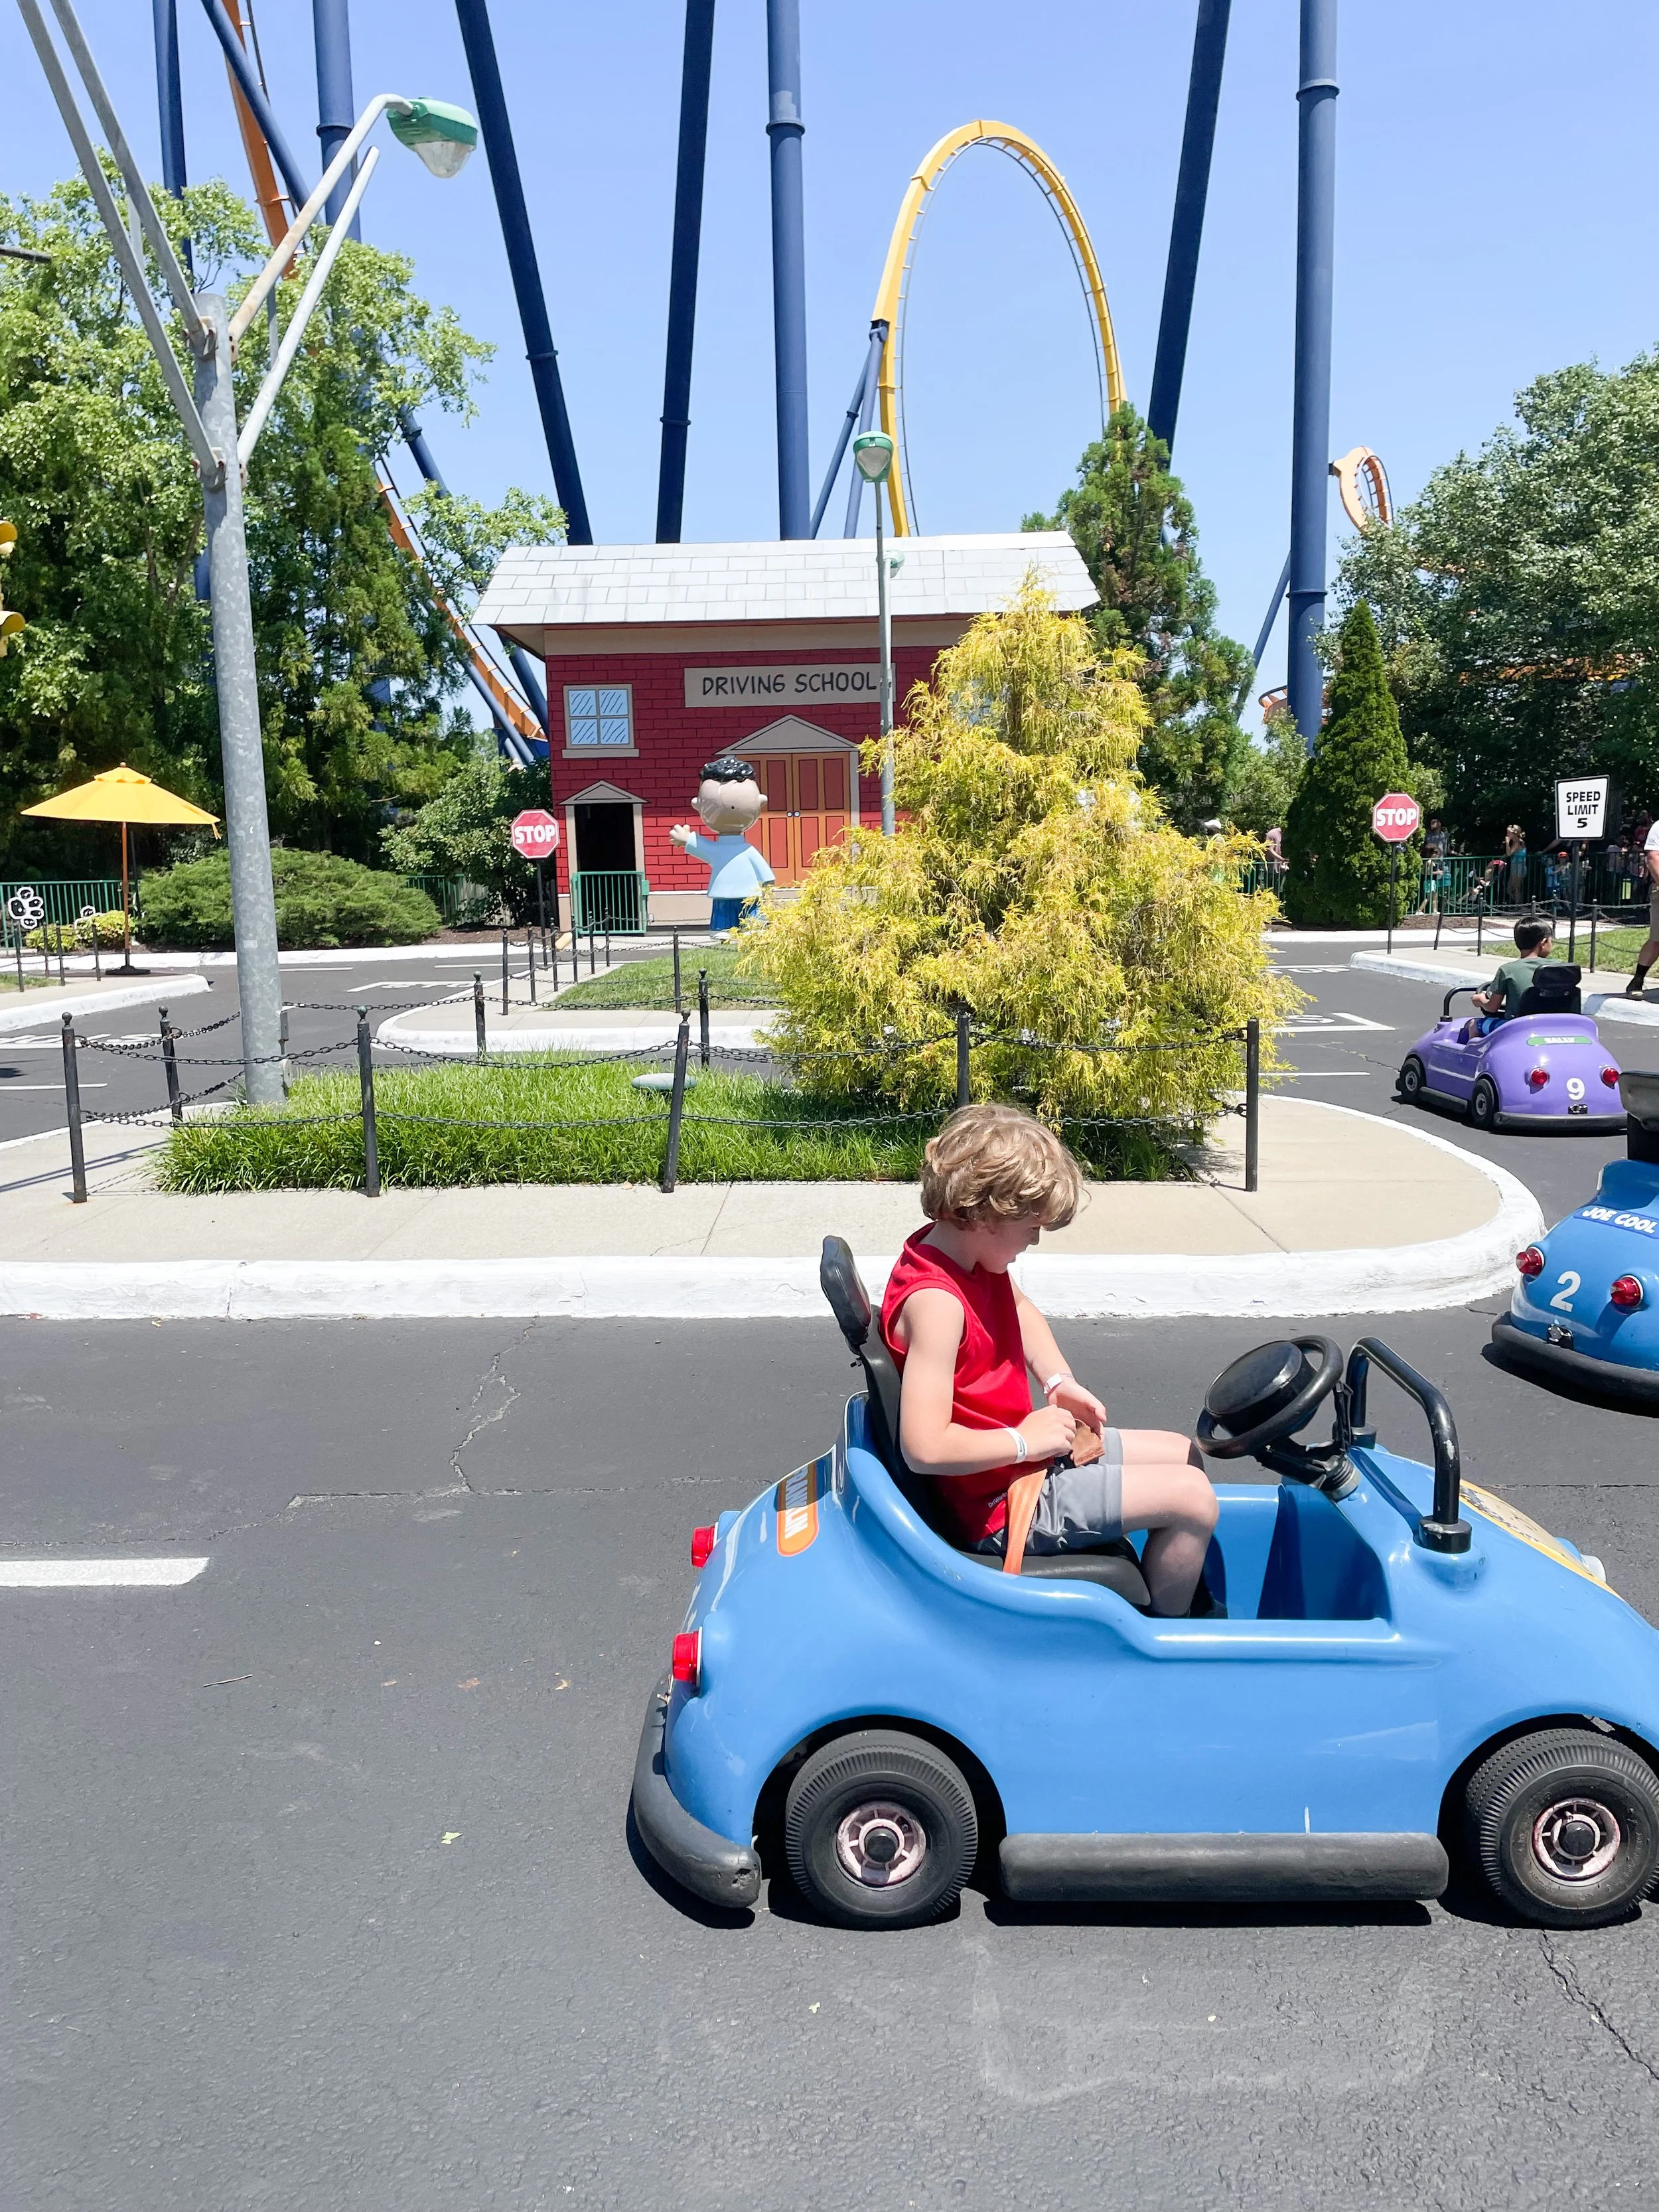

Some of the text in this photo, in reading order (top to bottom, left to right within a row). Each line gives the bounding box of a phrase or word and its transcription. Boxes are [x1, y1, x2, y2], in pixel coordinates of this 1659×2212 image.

[702, 671, 877, 696] DRIVING SCHOOL
[1566, 790, 1601, 802] SPEED
[1376, 808, 1417, 827] STOP
[1567, 804, 1599, 815] LIMIT
[1577, 818, 1588, 828] 5
[514, 824, 555, 845] STOP
[1566, 1077, 1585, 1100] 9
[1582, 1207, 1658, 1234] JOE COOL
[1550, 1270, 1581, 1313] 2
[784, 1464, 808, 1540] RANKLIN
